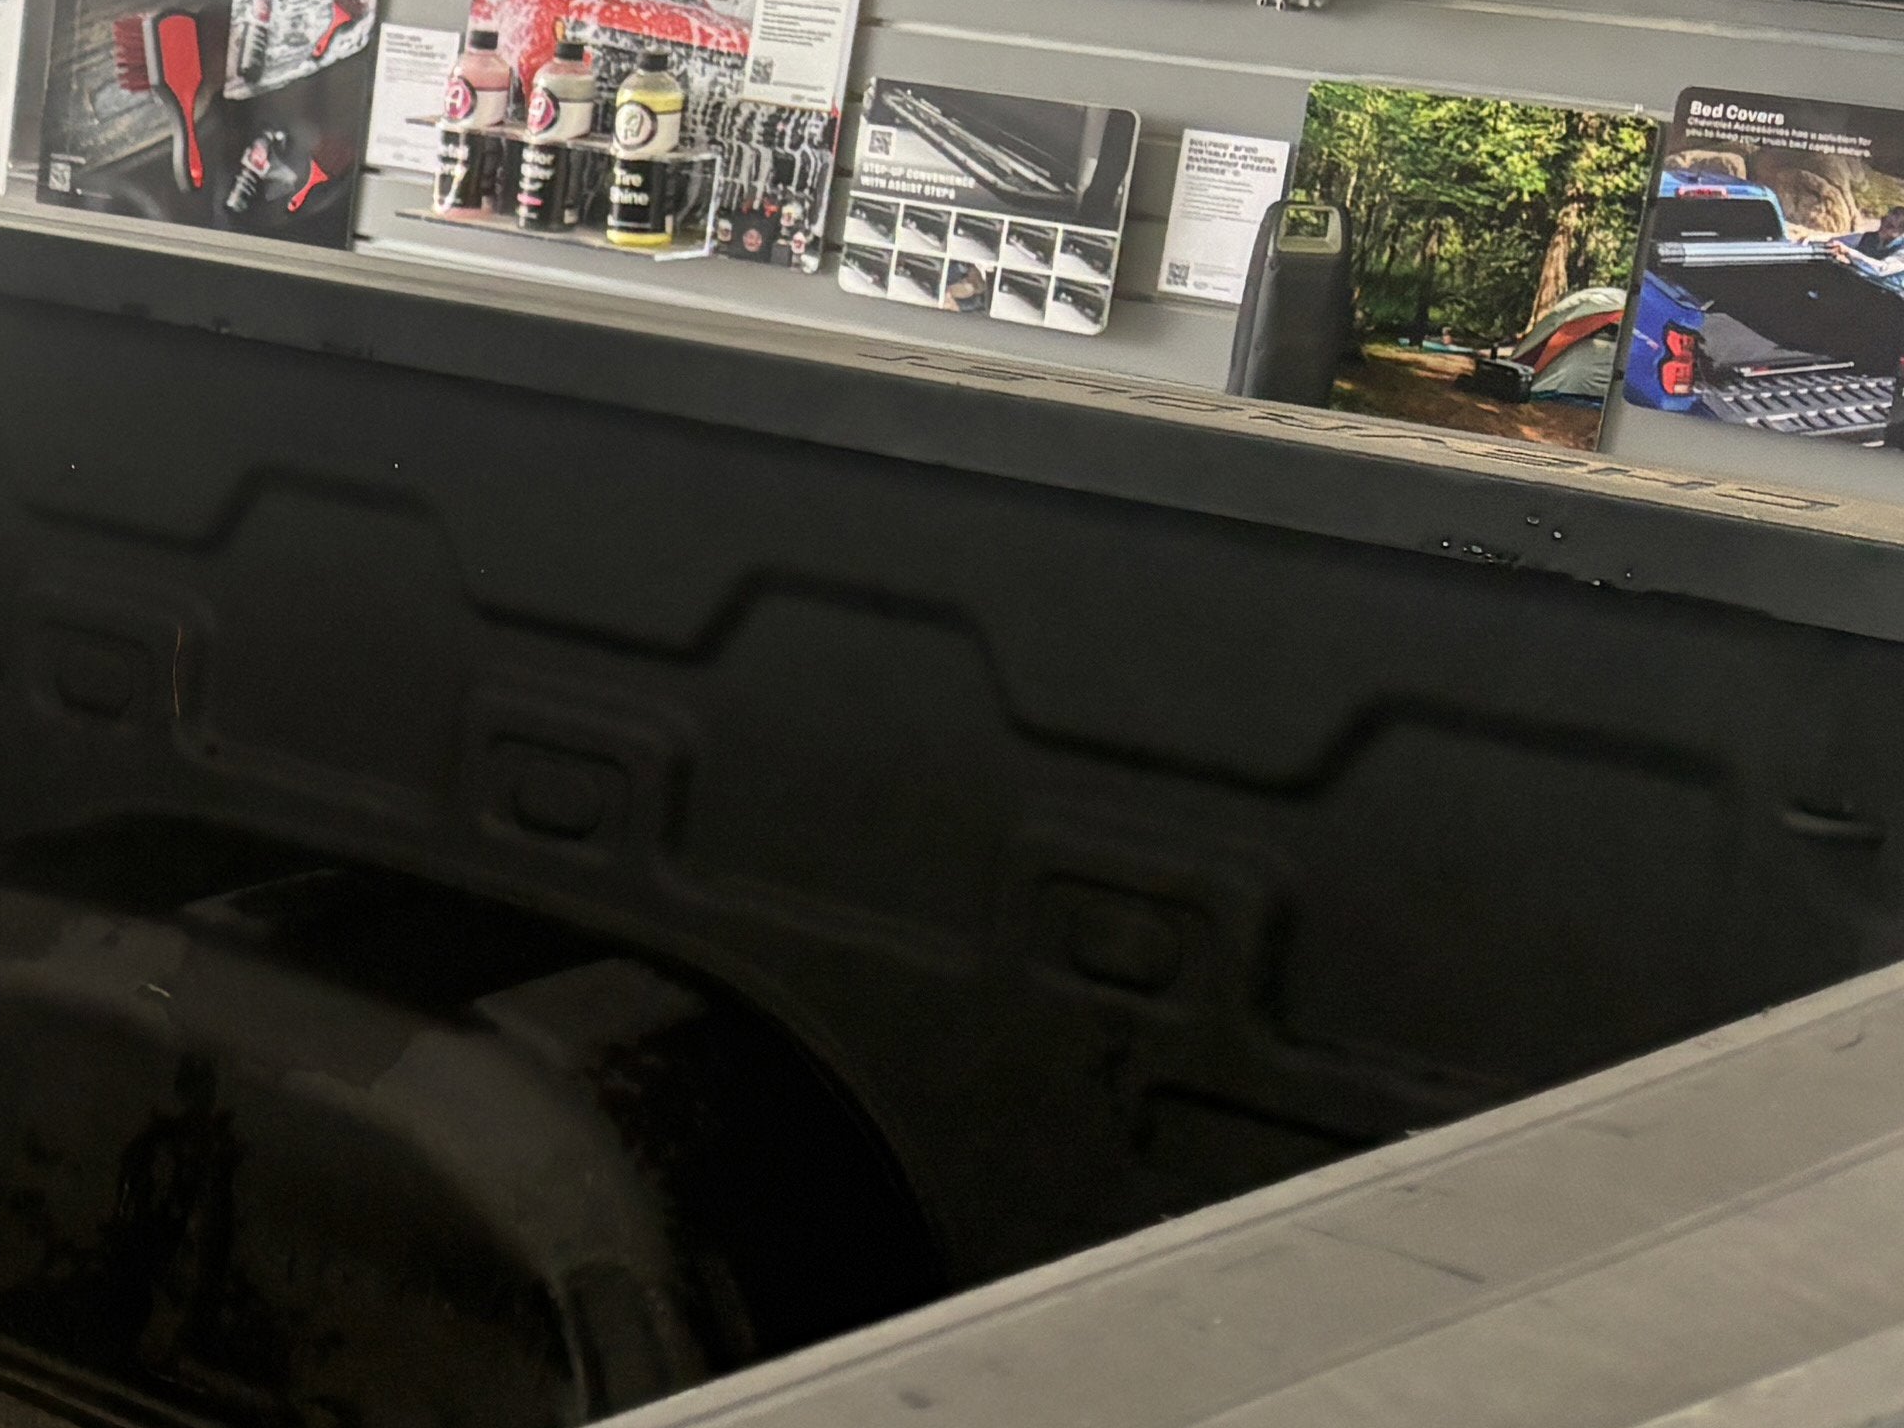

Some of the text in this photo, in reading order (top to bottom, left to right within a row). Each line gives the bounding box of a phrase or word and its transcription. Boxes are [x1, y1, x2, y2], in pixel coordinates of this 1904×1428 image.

[1690, 100, 1784, 125] Bed Covers
[1704, 129, 1714, 138] to
[1716, 130, 1738, 141] keep
[1762, 137, 1787, 147] truck
[1789, 139, 1808, 149] bed
[1808, 143, 1836, 154] cargo
[1734, 122, 1789, 137] Accessories
[1791, 129, 1808, 139] has
[1818, 133, 1857, 144] solution
[1858, 136, 1872, 146] for
[613, 169, 643, 187] Tire
[860, 175, 956, 200] WITH ASSIST STEPS
[862, 162, 976, 188] STEP-UP CONVENIENCE
